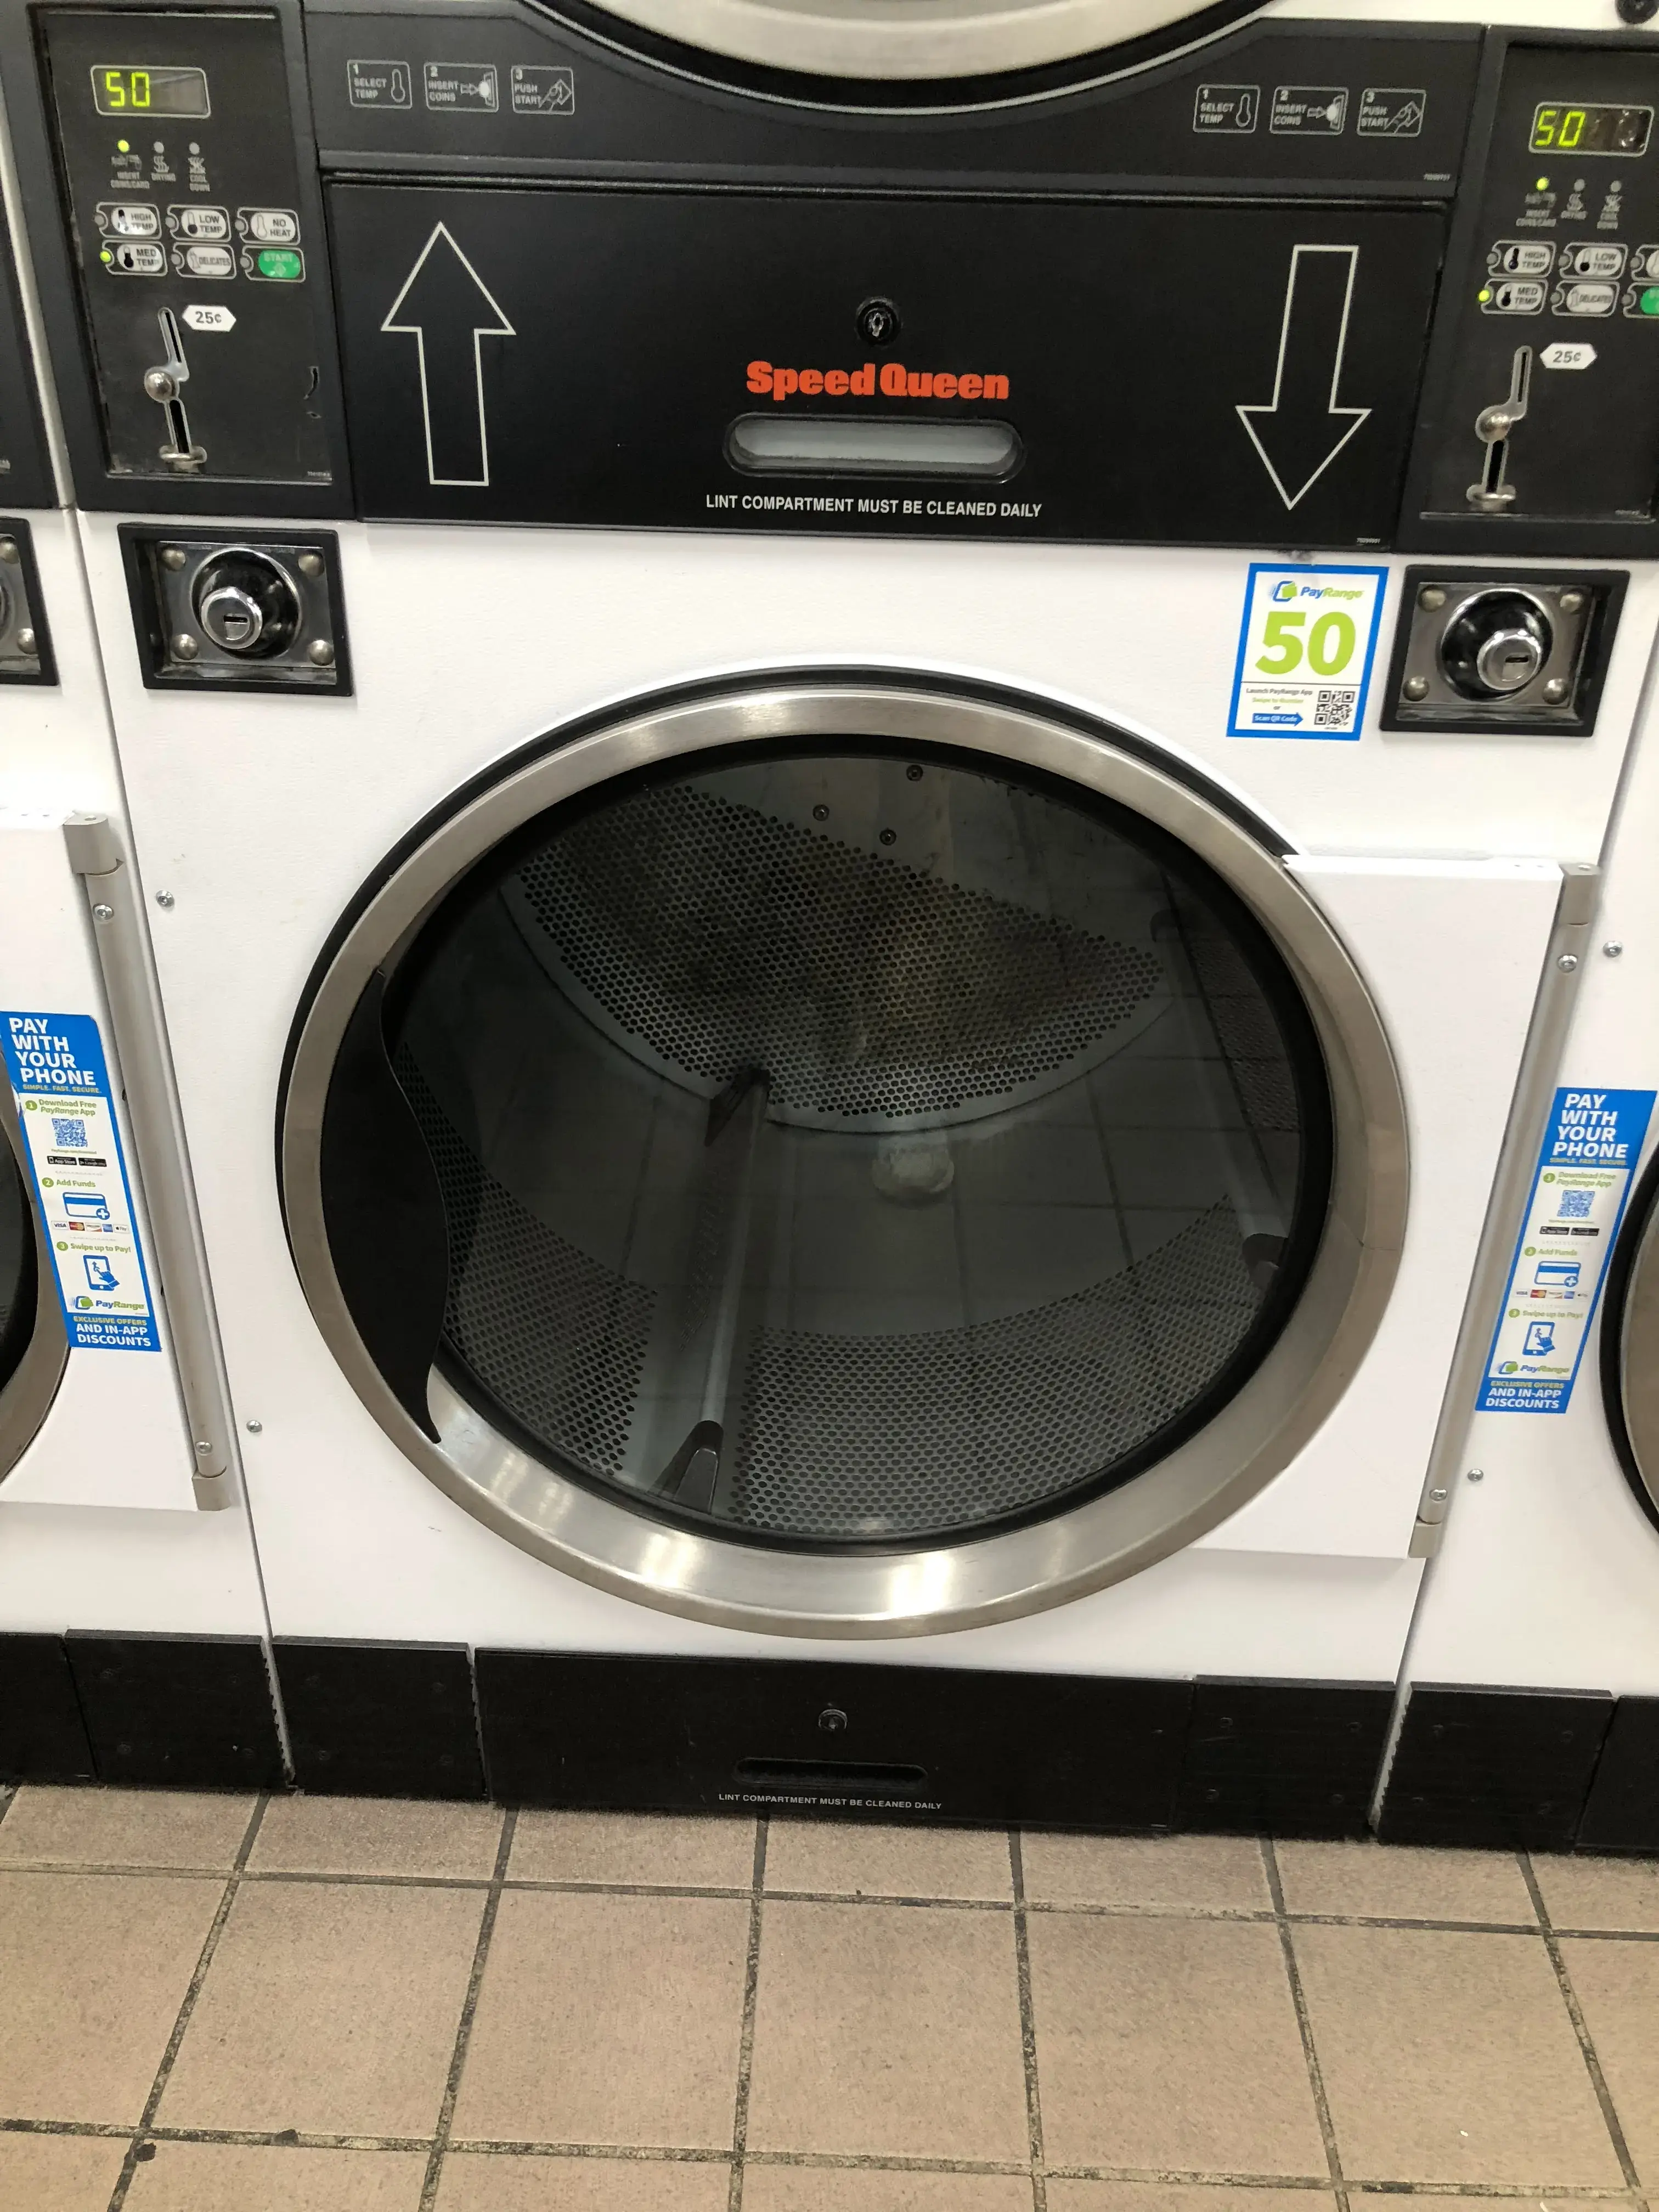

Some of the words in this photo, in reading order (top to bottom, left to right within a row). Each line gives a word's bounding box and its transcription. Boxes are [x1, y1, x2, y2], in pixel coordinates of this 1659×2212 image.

[353, 64, 360, 75] 1
[430, 66, 438, 77] 2
[515, 67, 523, 80] 3
[353, 77, 387, 87] SELECT
[428, 80, 459, 90] INSERT
[105, 72, 150, 107] 50
[514, 83, 538, 93] PUSH
[355, 89, 379, 99] TEMP
[428, 92, 456, 102] COINS
[515, 95, 541, 104] START
[1203, 89, 1209, 100] 1
[1280, 89, 1289, 101] 2
[1365, 91, 1375, 103] 3
[1200, 103, 1234, 113] SELECT
[1276, 104, 1307, 114] INSERT
[1362, 106, 1387, 116] PUSH
[1199, 114, 1224, 124] TEMP
[1274, 116, 1301, 126] COINS
[1361, 117, 1390, 128] START
[1535, 110, 1586, 147] 50
[131, 212, 152, 221] HIGH
[199, 215, 220, 223] LOW
[132, 223, 154, 231] TEMP
[272, 219, 287, 227] NO
[199, 225, 223, 234] TEMP
[270, 229, 292, 238] HEAT
[136, 249, 157, 257] MED
[263, 251, 294, 262] START
[1595, 252, 1617, 261] LOW
[137, 258, 160, 267] TEMP
[199, 256, 232, 267] DELICATES
[1517, 287, 1538, 295] MED
[1515, 297, 1537, 305] TEMP
[746, 360, 876, 401] Speed
[879, 363, 1010, 400] Queen
[706, 494, 738, 509] LINT
[742, 495, 854, 513] COMPARTMENT
[857, 498, 898, 514] MUST
[902, 500, 923, 515] BE
[926, 500, 997, 517] CLEANED
[1001, 502, 1042, 518] DAILY
[1300, 586, 1363, 600] PayRange
[1255, 611, 1356, 676] 50
[1269, 688, 1300, 696] PayRange
[9, 1017, 48, 1034] PAY
[11, 1035, 70, 1052] WITH
[14, 1051, 77, 1069] YOUR
[20, 1068, 96, 1086] PHONE
[38, 1098, 78, 1108] Download
[1564, 1093, 1607, 1109] PAY
[41, 1106, 80, 1116] PayRange
[80, 1108, 96, 1117] App
[1561, 1109, 1618, 1126] WITH
[1557, 1125, 1617, 1142] YOUR
[1552, 1141, 1629, 1159] PHONE
[72, 1180, 96, 1188] Funds
[1556, 1178, 1595, 1187] PayRange
[1595, 1180, 1612, 1188] App
[70, 1243, 93, 1251] Swipe
[114, 1245, 132, 1254] Pay!
[95, 1300, 145, 1310] PayRange
[73, 1316, 115, 1324] EXCLUSIVE
[116, 1318, 147, 1326] OFFERS
[76, 1323, 103, 1333] AND
[104, 1324, 148, 1335] IN-APP
[77, 1334, 151, 1347] DISCOUNTS
[1520, 1364, 1570, 1374] PayRange
[1488, 1387, 1516, 1397] AND
[1517, 1389, 1562, 1398] IN-APP
[1485, 1397, 1560, 1409] DISCOUNTS
[718, 1793, 741, 1802] LINT
[742, 1794, 817, 1804] COMPARTMENT
[820, 1797, 847, 1806] MUST
[865, 1799, 912, 1809] CLEANED
[915, 1802, 942, 1810] DAILY
